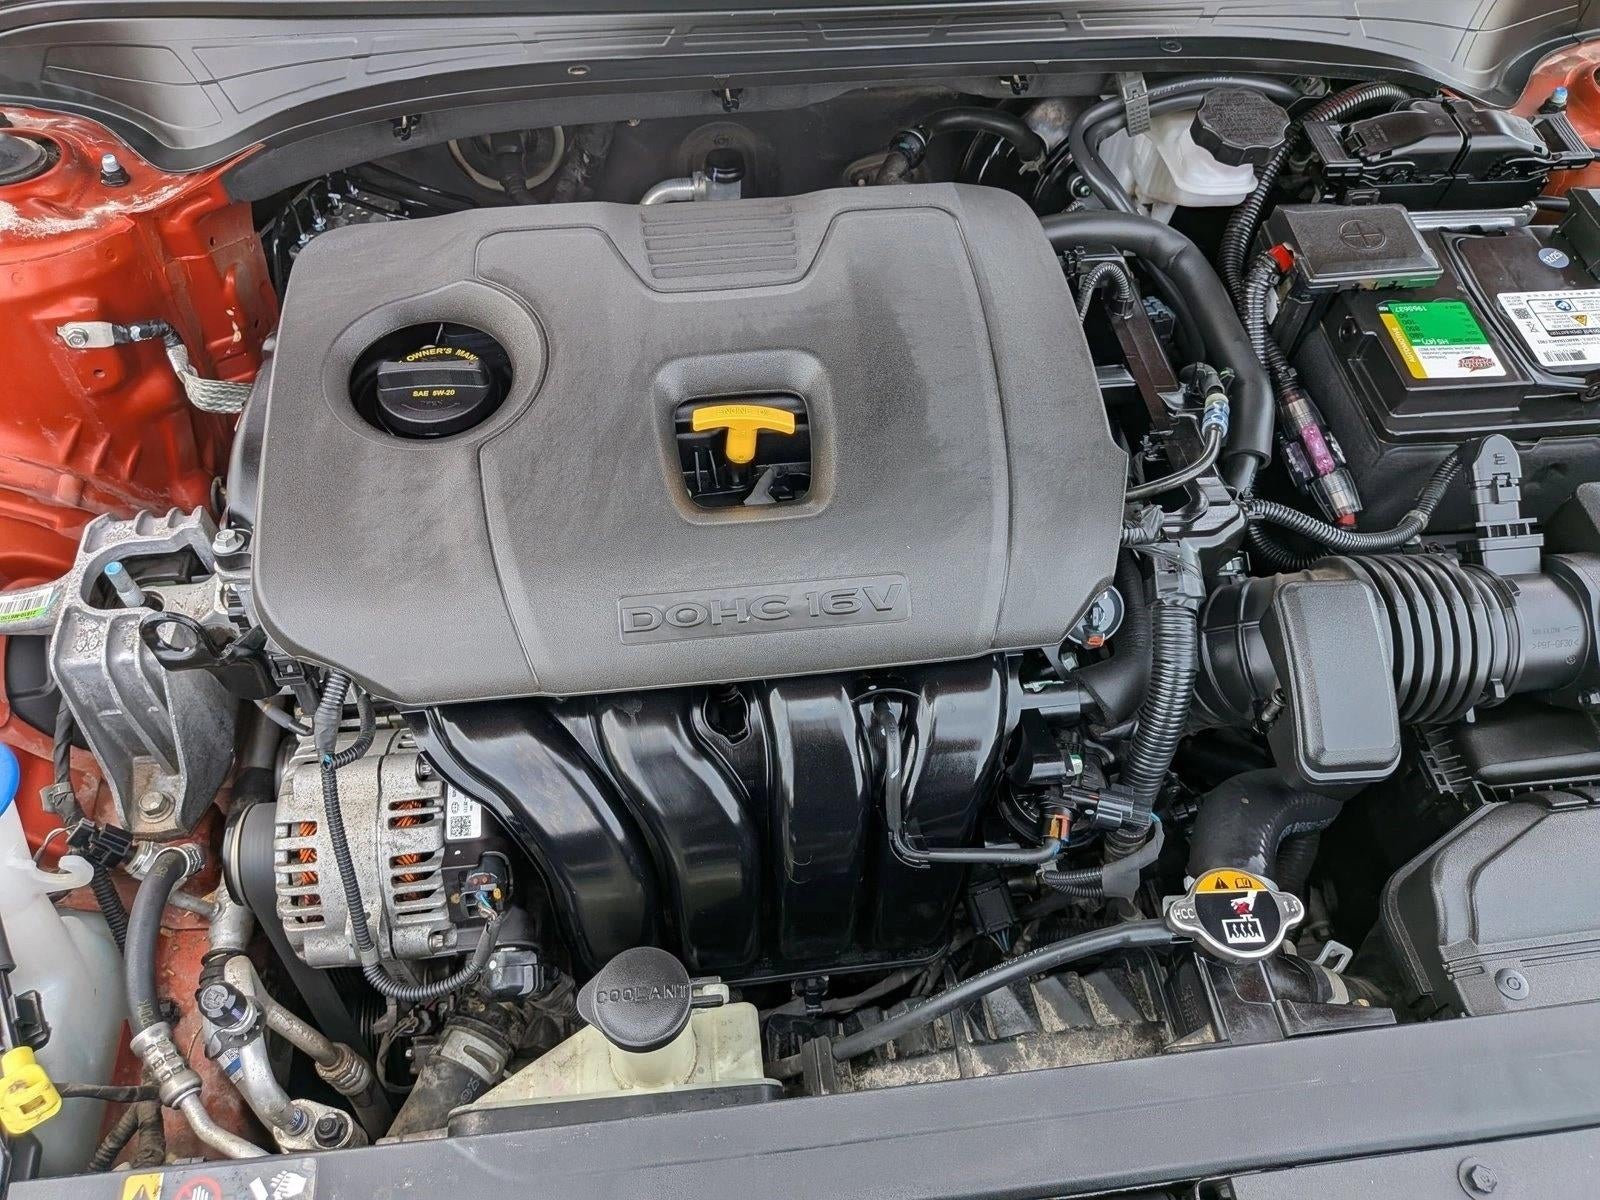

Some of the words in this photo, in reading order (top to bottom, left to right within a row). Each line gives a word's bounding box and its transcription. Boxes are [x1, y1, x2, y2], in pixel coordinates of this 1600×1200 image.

[1391, 327, 1416, 363] AUTOMOTIVE
[406, 347, 452, 362] OWNER'S
[455, 348, 478, 362] MAN
[432, 389, 456, 397] 5W-20
[621, 594, 791, 633] DOHC
[806, 584, 902, 617] 16V
[1173, 908, 1195, 919] HCC
[596, 984, 690, 1005] COOLANT
